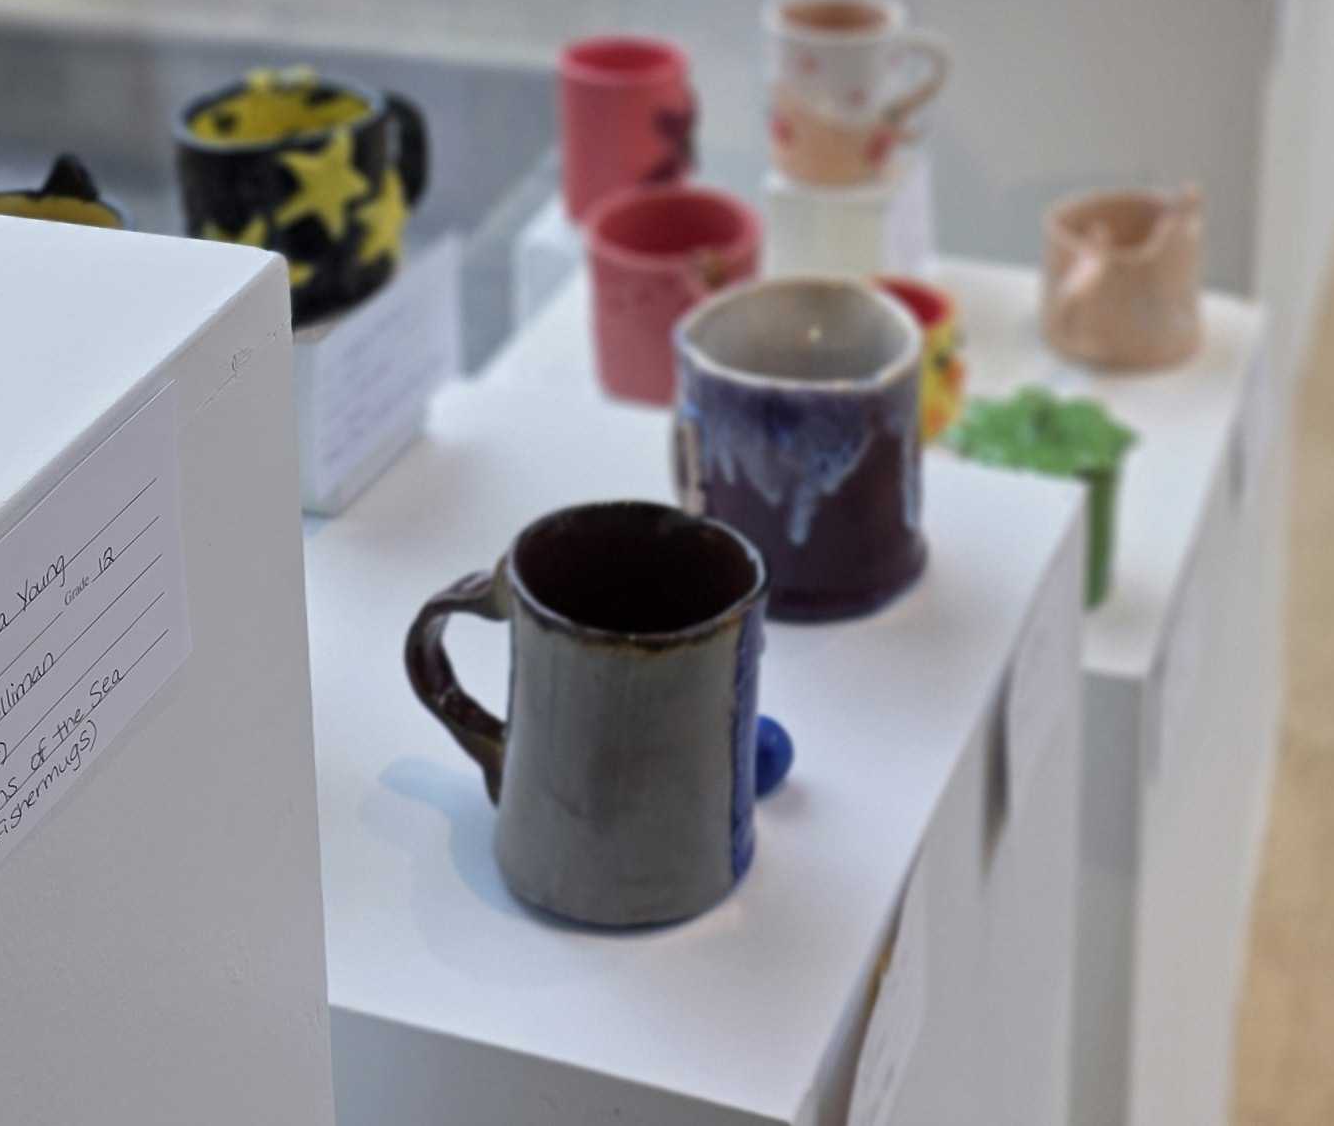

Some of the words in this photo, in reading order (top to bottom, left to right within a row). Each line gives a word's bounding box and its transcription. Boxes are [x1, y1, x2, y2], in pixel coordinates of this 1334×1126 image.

[17, 555, 65, 610] Young
[64, 576, 89, 605] Grade
[98, 547, 114, 573] 12
[30, 737, 47, 772] of
[52, 708, 84, 745] the
[89, 669, 124, 708] Sea
